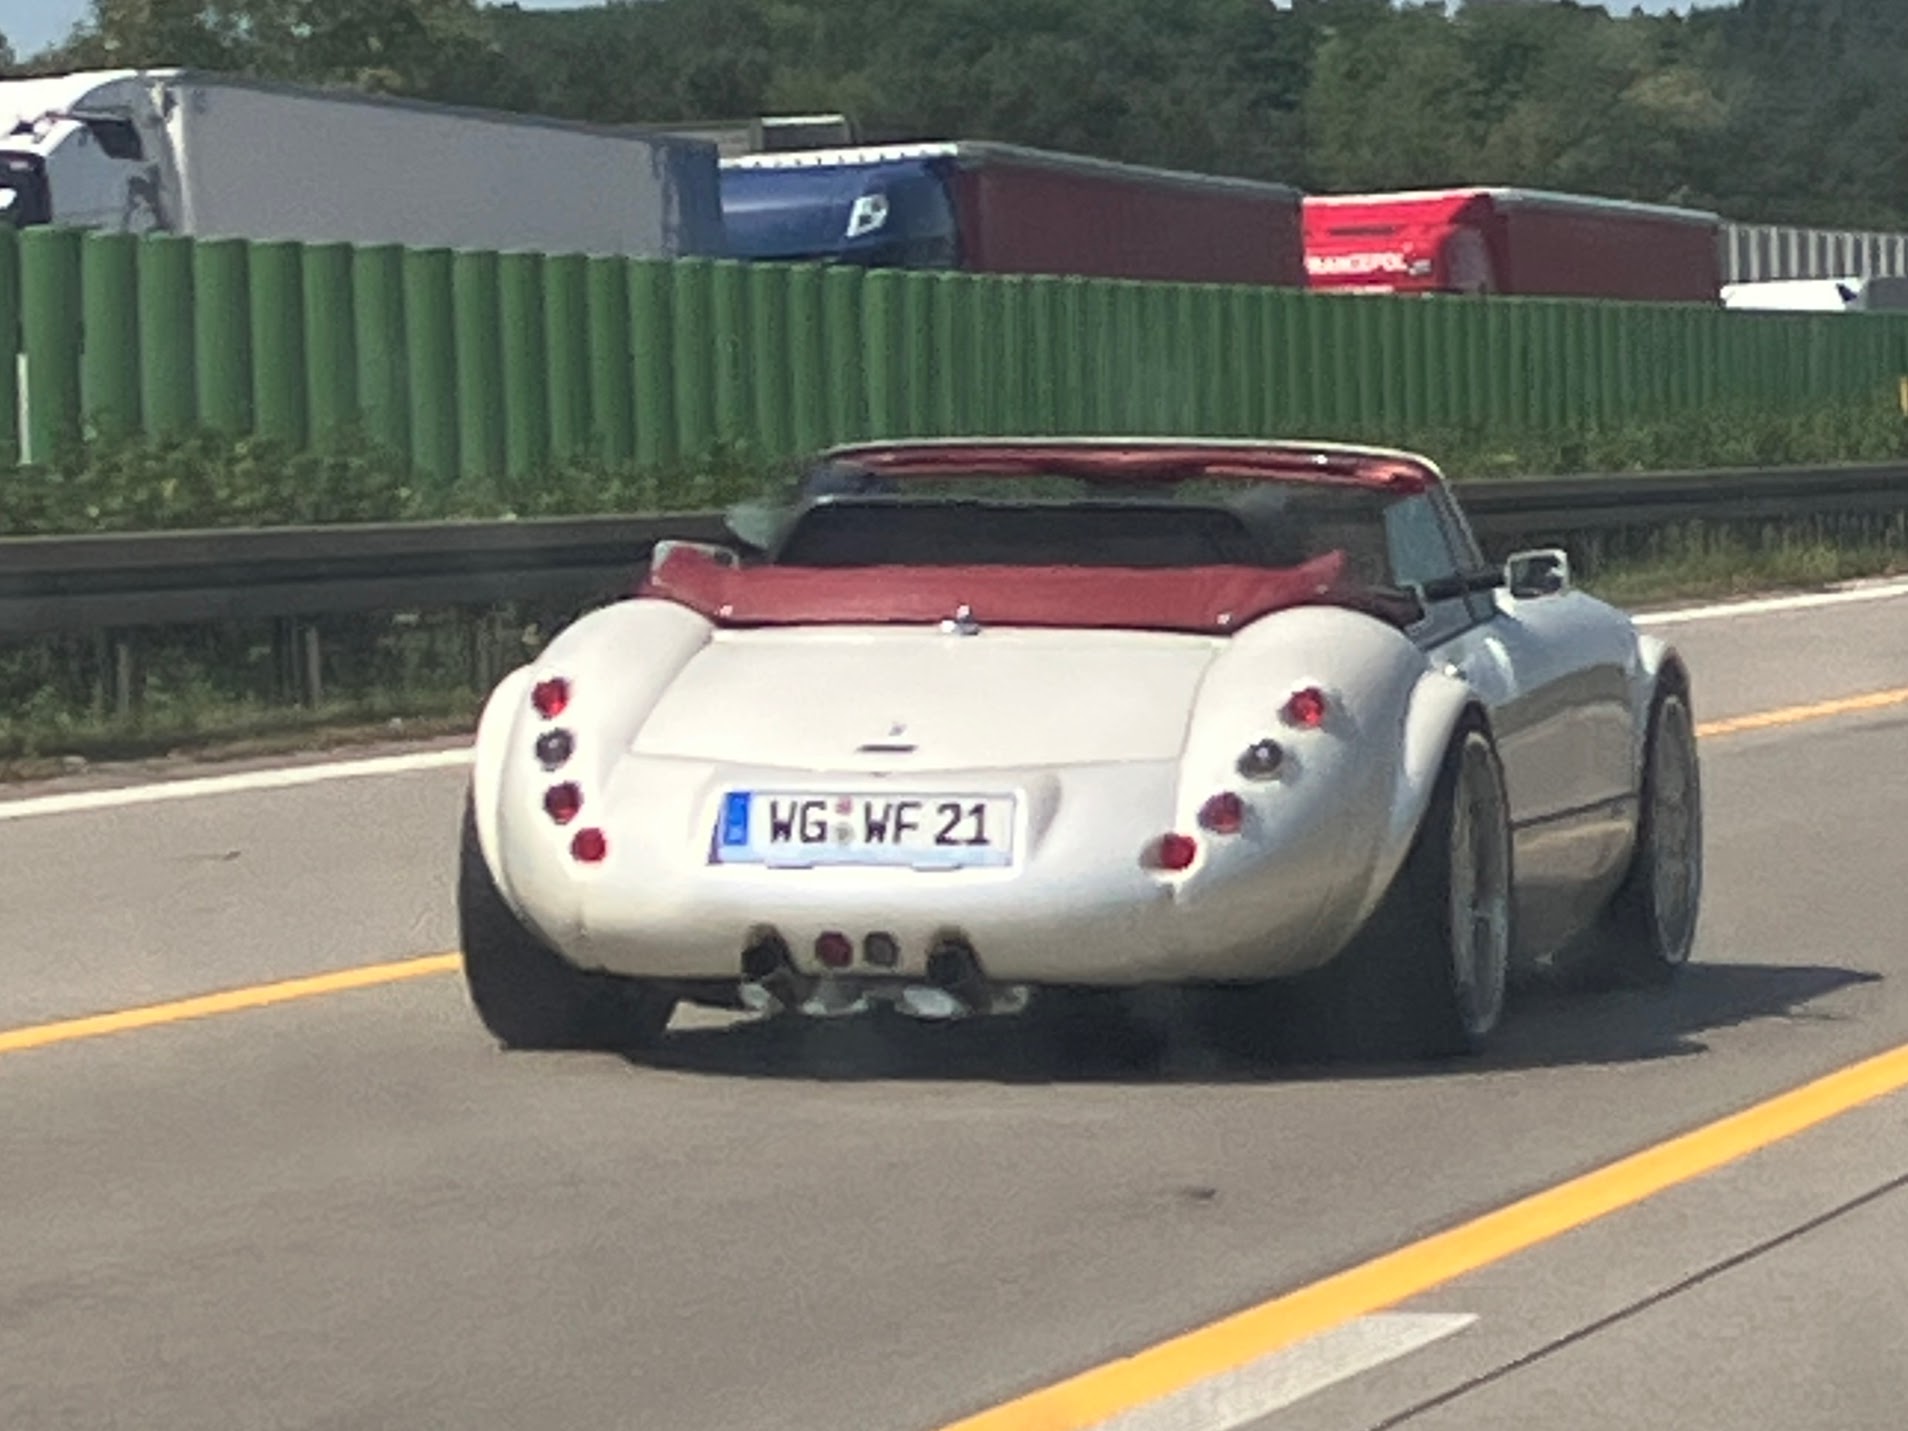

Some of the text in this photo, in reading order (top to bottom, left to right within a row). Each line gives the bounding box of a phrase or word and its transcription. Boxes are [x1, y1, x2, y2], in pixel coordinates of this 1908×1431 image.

[769, 801, 991, 845] WG WF 21
